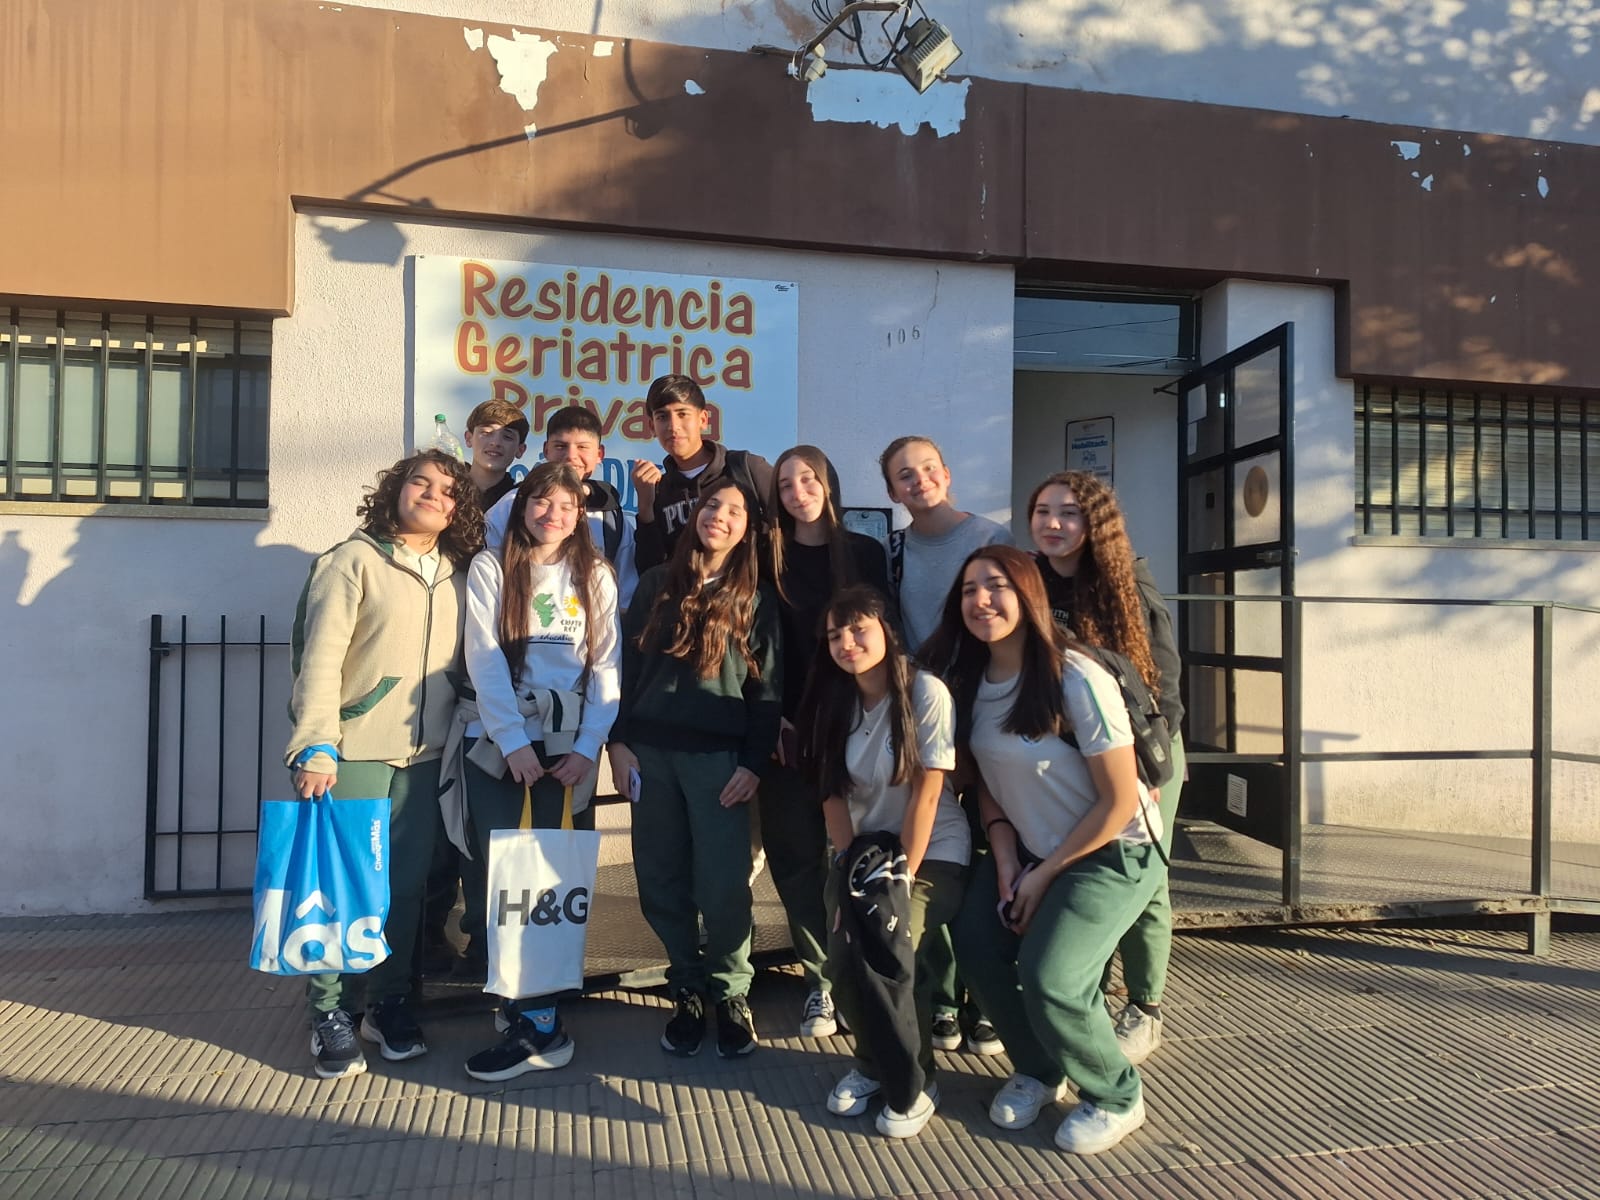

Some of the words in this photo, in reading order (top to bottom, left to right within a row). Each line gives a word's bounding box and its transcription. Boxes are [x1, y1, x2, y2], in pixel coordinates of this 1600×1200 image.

[460, 261, 755, 335] Residencia
[456, 321, 752, 389] Geriatrica
[887, 325, 920, 348] 106
[493, 380, 721, 441] Privaa
[498, 887, 588, 926] H&G
